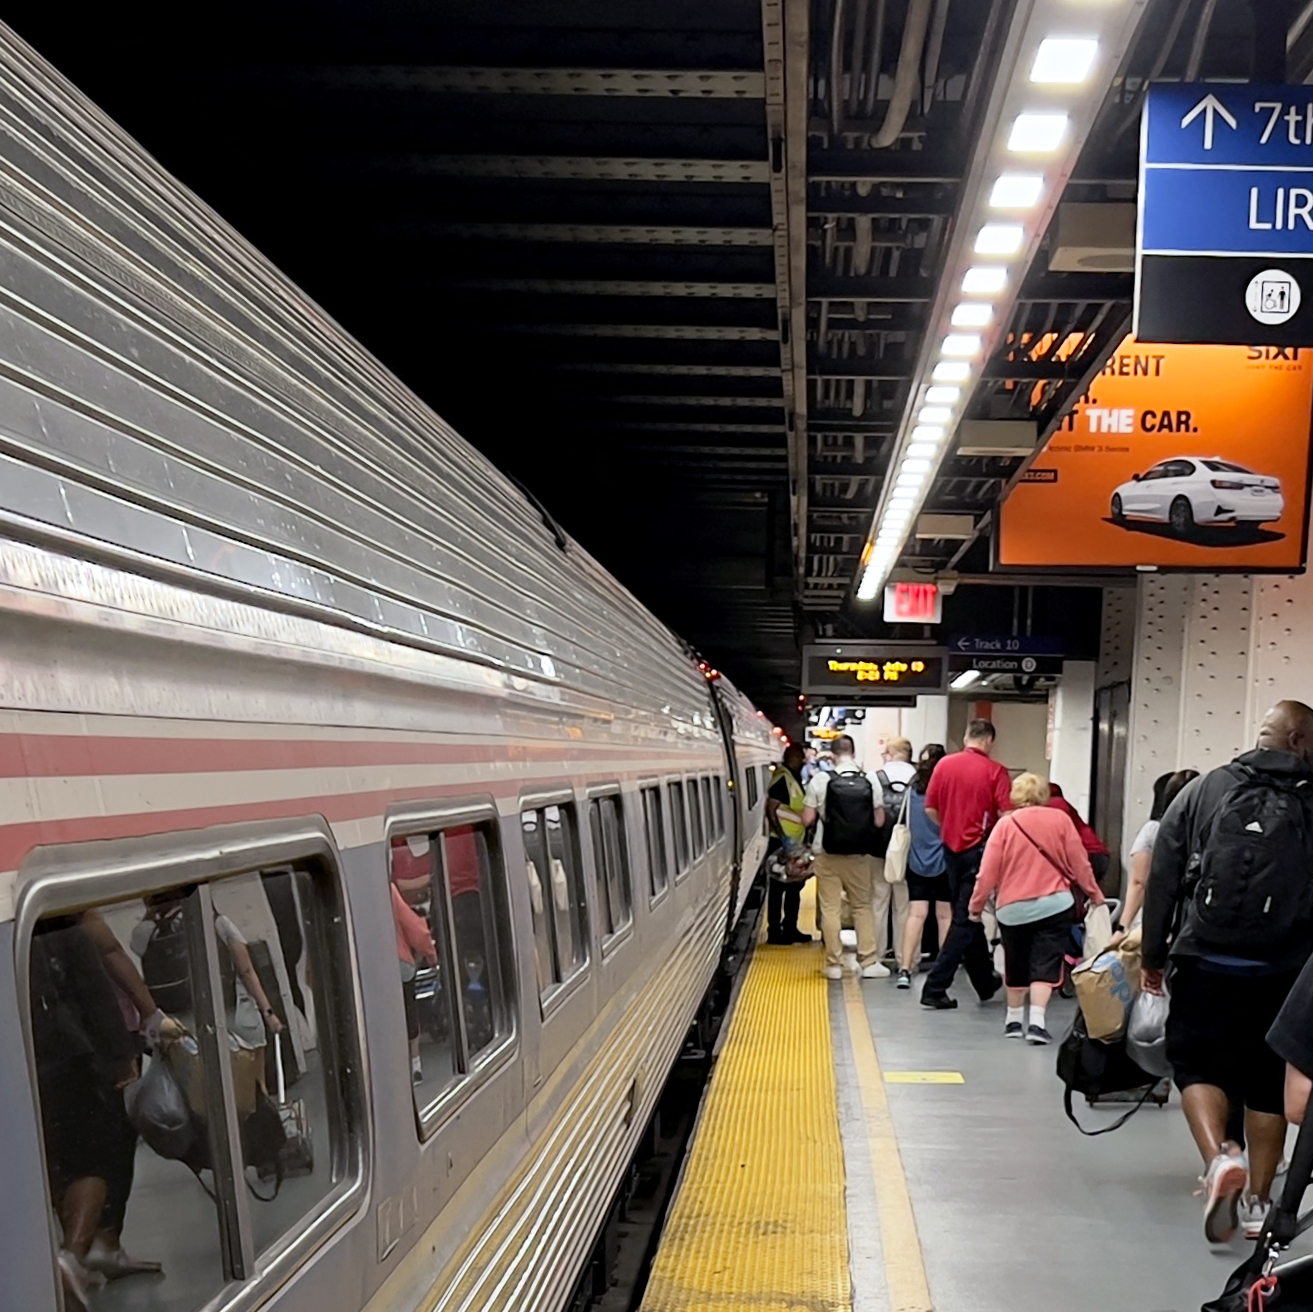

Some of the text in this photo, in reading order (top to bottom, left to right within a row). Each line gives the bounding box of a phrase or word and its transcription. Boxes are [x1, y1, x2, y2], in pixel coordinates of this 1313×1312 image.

[1086, 408, 1134, 433] THE
[1140, 410, 1198, 433] CAR.
[895, 583, 937, 618] EXIT
[974, 638, 1020, 651] Track 10
[972, 659, 1018, 669] Location
